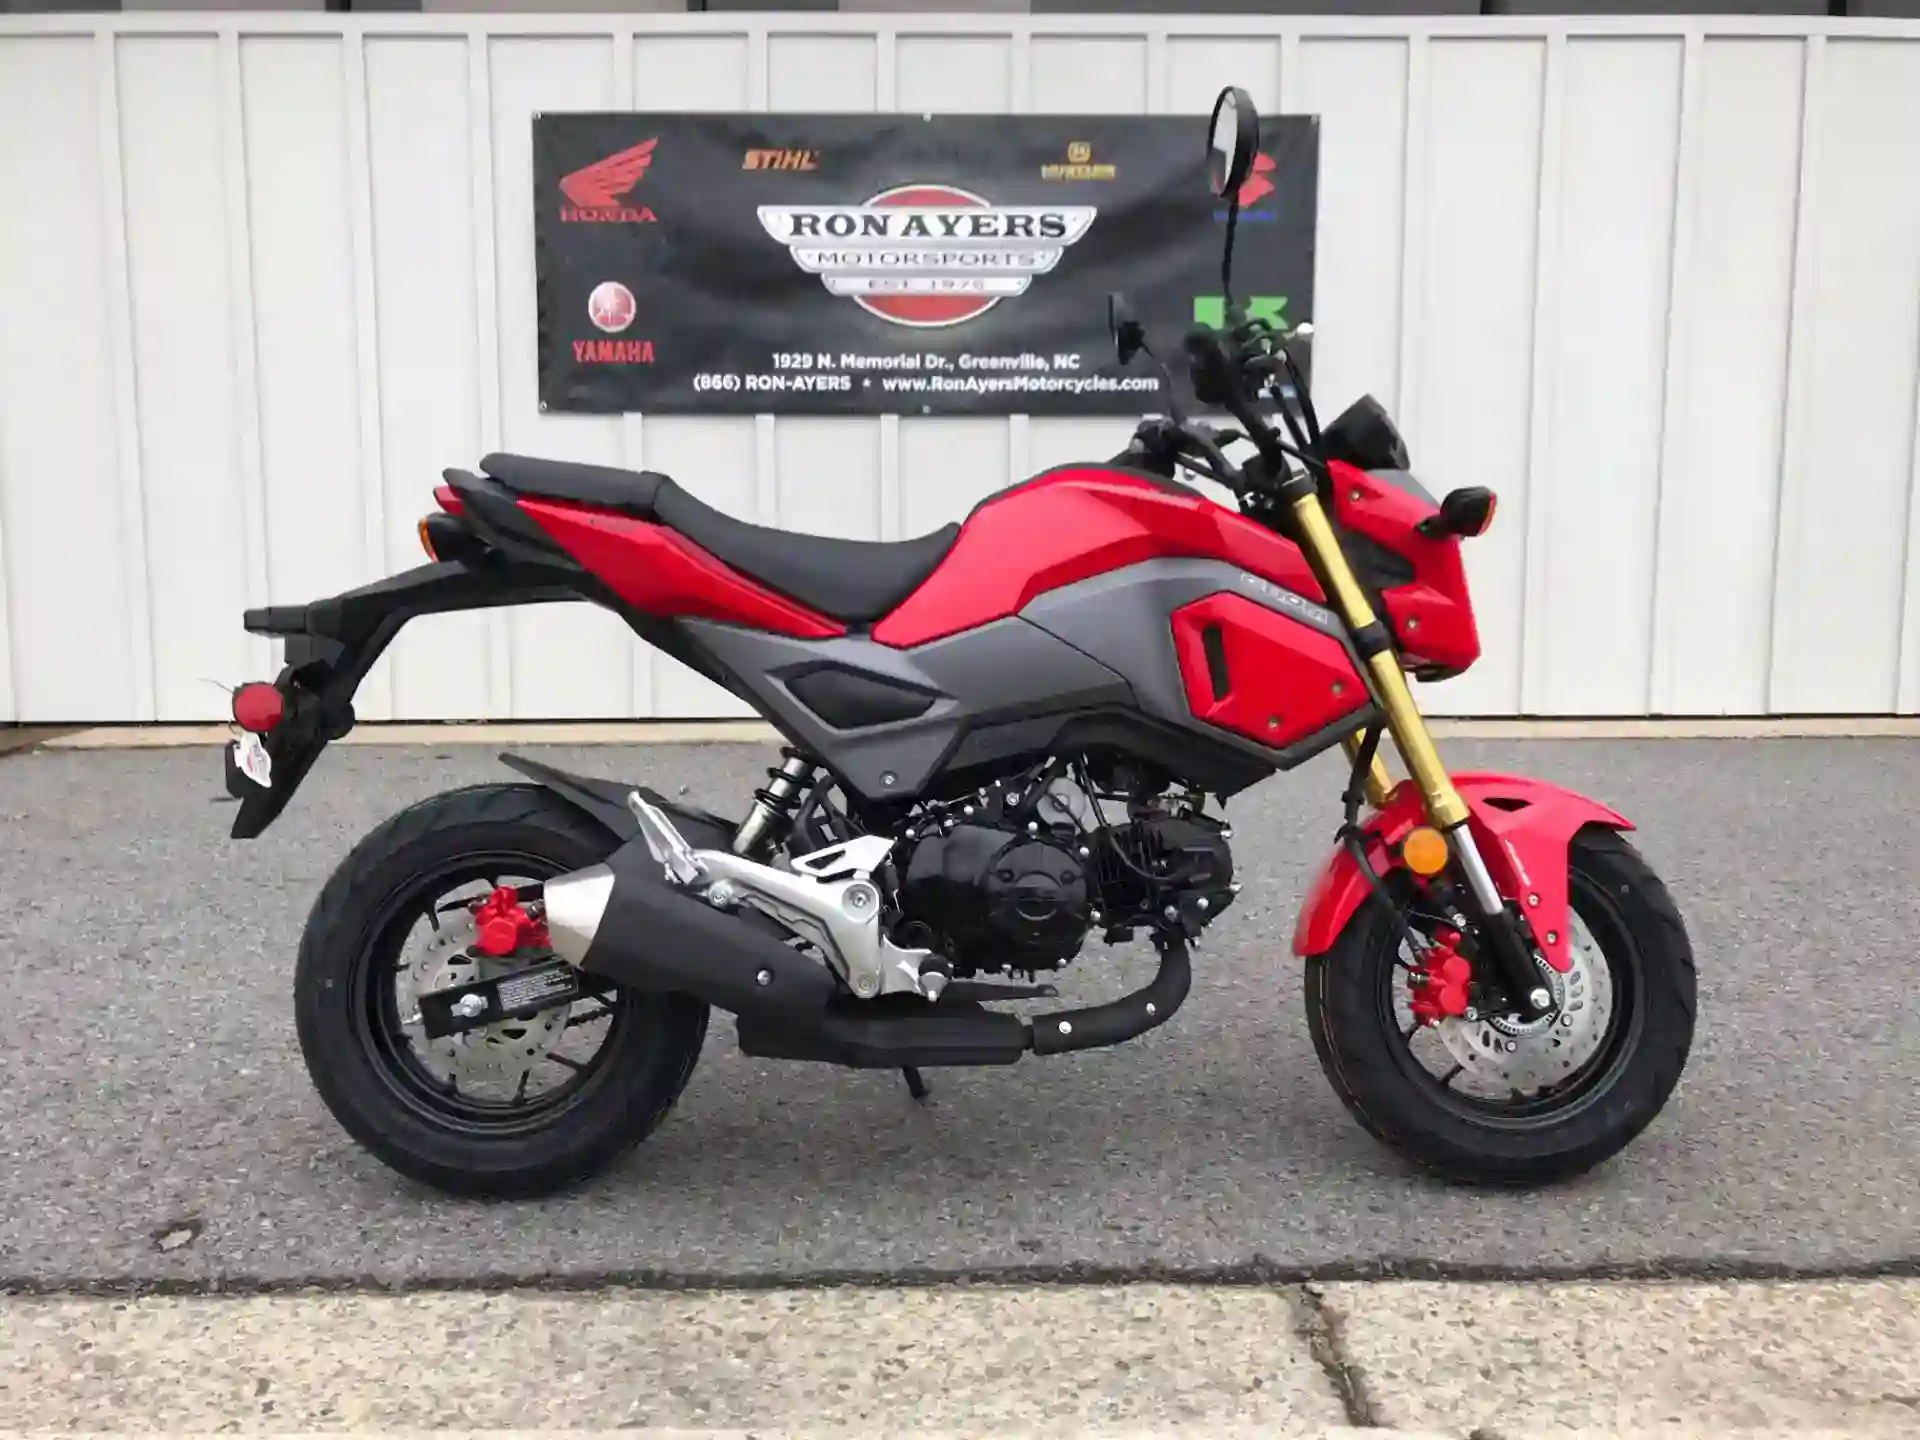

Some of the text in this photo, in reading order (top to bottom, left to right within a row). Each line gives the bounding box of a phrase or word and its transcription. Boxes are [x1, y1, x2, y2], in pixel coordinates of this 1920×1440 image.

[741, 149, 819, 170] STIHL
[559, 206, 658, 222] HONDA
[789, 213, 1066, 238] RON AYERS
[818, 252, 1036, 266] MOTORSPORTS
[572, 339, 656, 363] YAMAHA
[772, 352, 813, 370] 1929
[817, 352, 836, 370] N.
[840, 353, 921, 370] Memorial
[959, 353, 1050, 373] Greenville,
[1054, 353, 1081, 371] NC
[745, 374, 852, 391] RON-AYERS
[882, 374, 1160, 394] www.RonAyersMotorcycles.com
